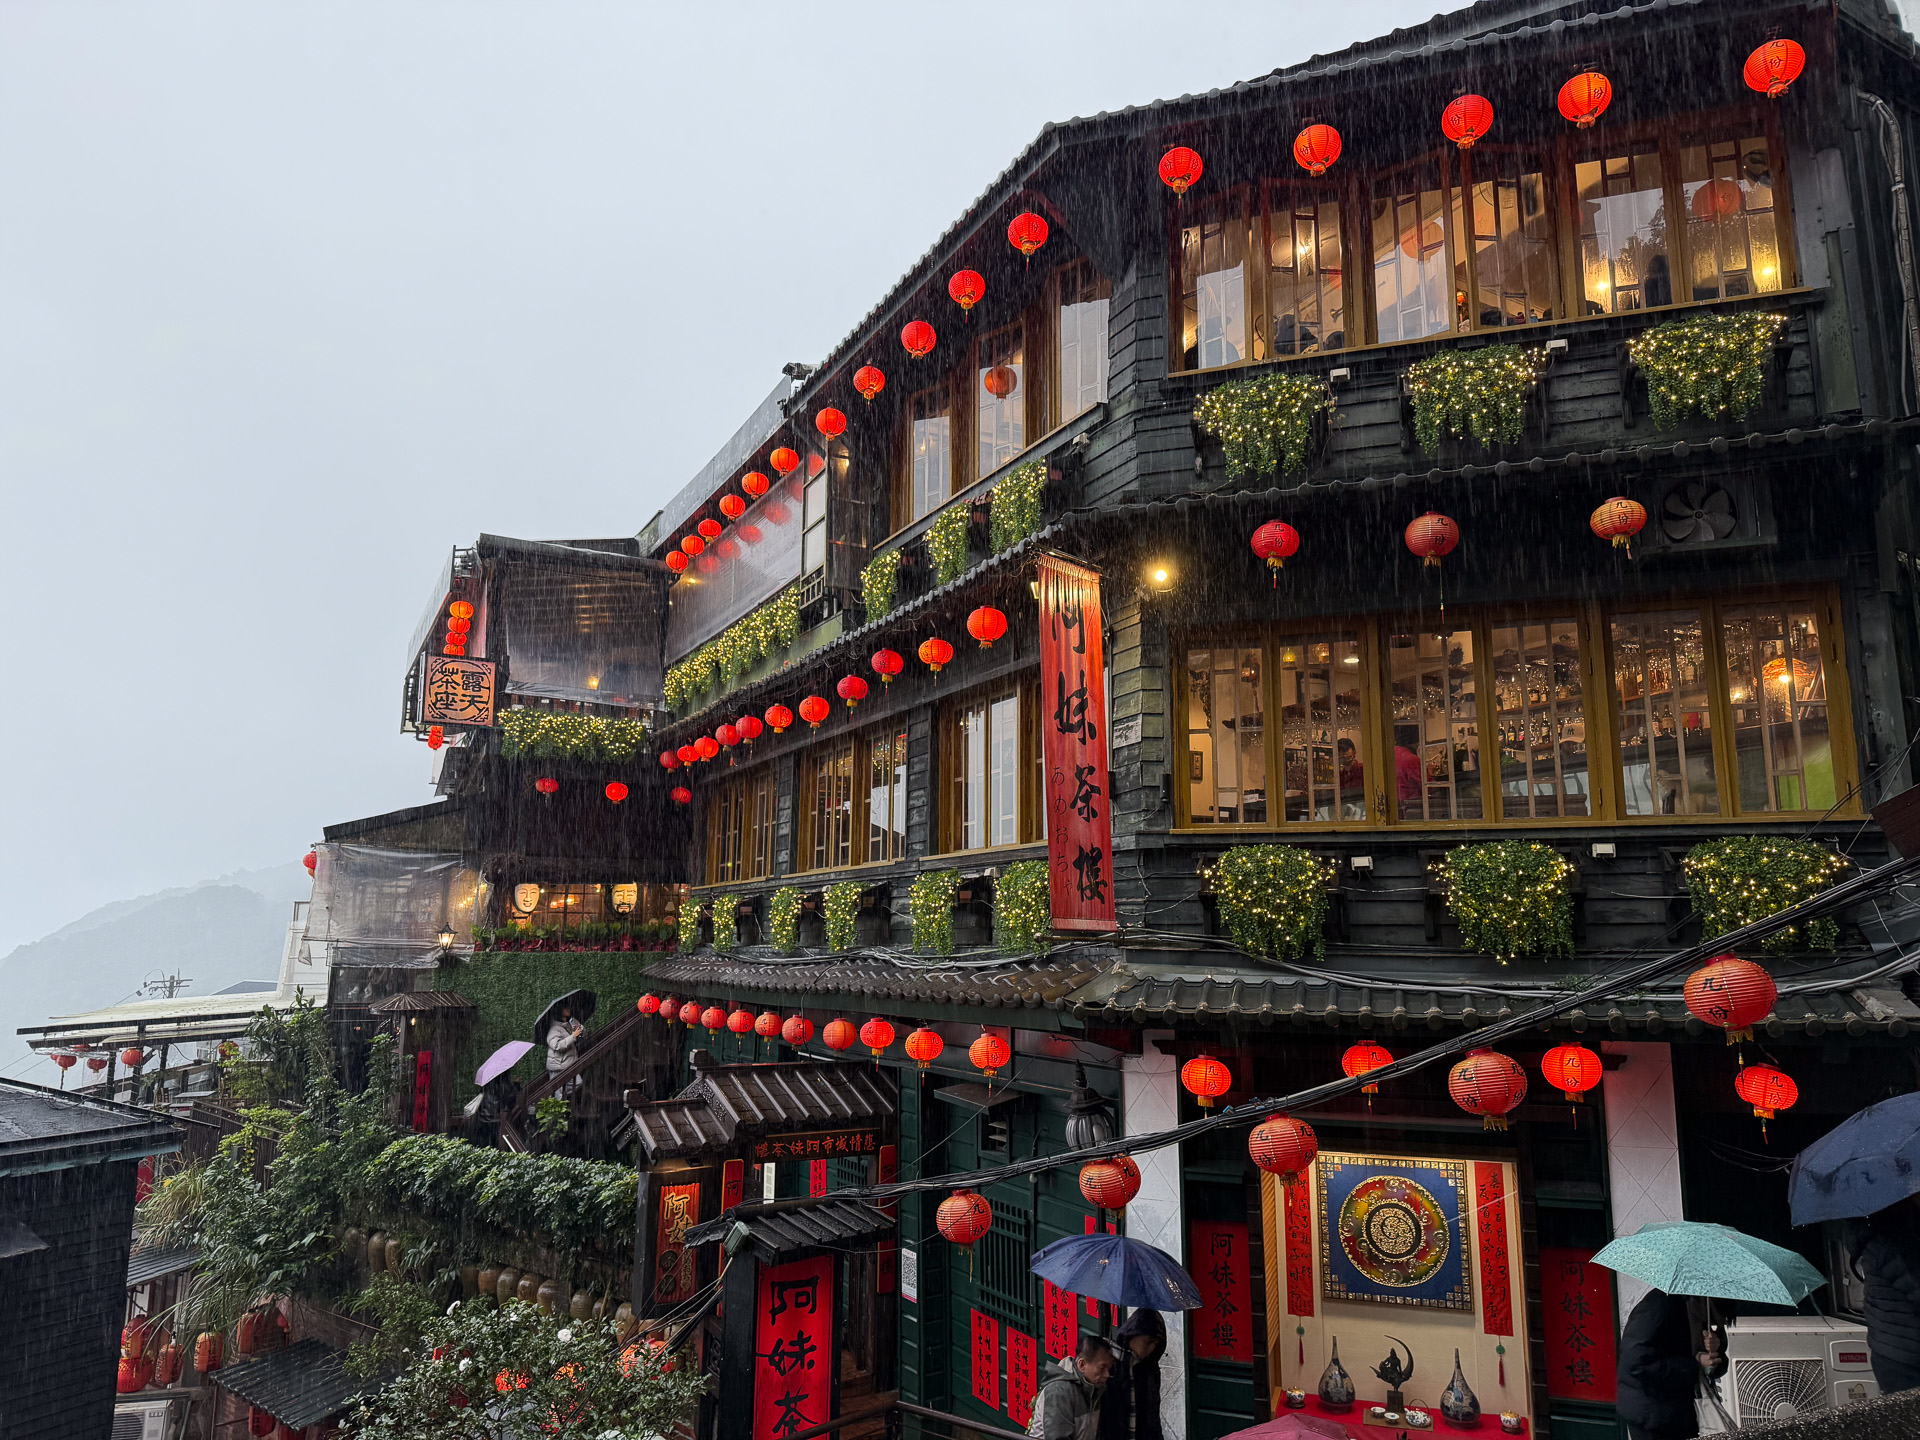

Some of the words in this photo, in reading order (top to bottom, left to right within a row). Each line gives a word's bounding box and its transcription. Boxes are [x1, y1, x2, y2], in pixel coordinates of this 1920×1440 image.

[1615, 502, 1629, 525] 九份
[1274, 524, 1285, 548] 九份
[431, 667, 461, 711] 茶座
[460, 669, 489, 712] 露天
[1052, 573, 1108, 905] 阿妹茶樓
[1702, 977, 1730, 1020] 九份
[1207, 1065, 1218, 1091] 九份
[1457, 1067, 1479, 1108] 九份
[1511, 1062, 1525, 1104] 九份
[1565, 1057, 1581, 1088] 九份
[1769, 1075, 1783, 1104] 九份
[755, 1134, 876, 1157] 悲情城市阿妹茶樓
[1256, 1129, 1272, 1167] 九份
[1300, 1125, 1314, 1163] 九份
[1123, 1166, 1136, 1201] 九份
[972, 1203, 984, 1237] 九份
[1208, 1232, 1239, 1350] 阿妹茶樓
[1560, 1261, 1597, 1386] 阿妹茶樓
[756, 1275, 820, 1437] 阿妹茶
